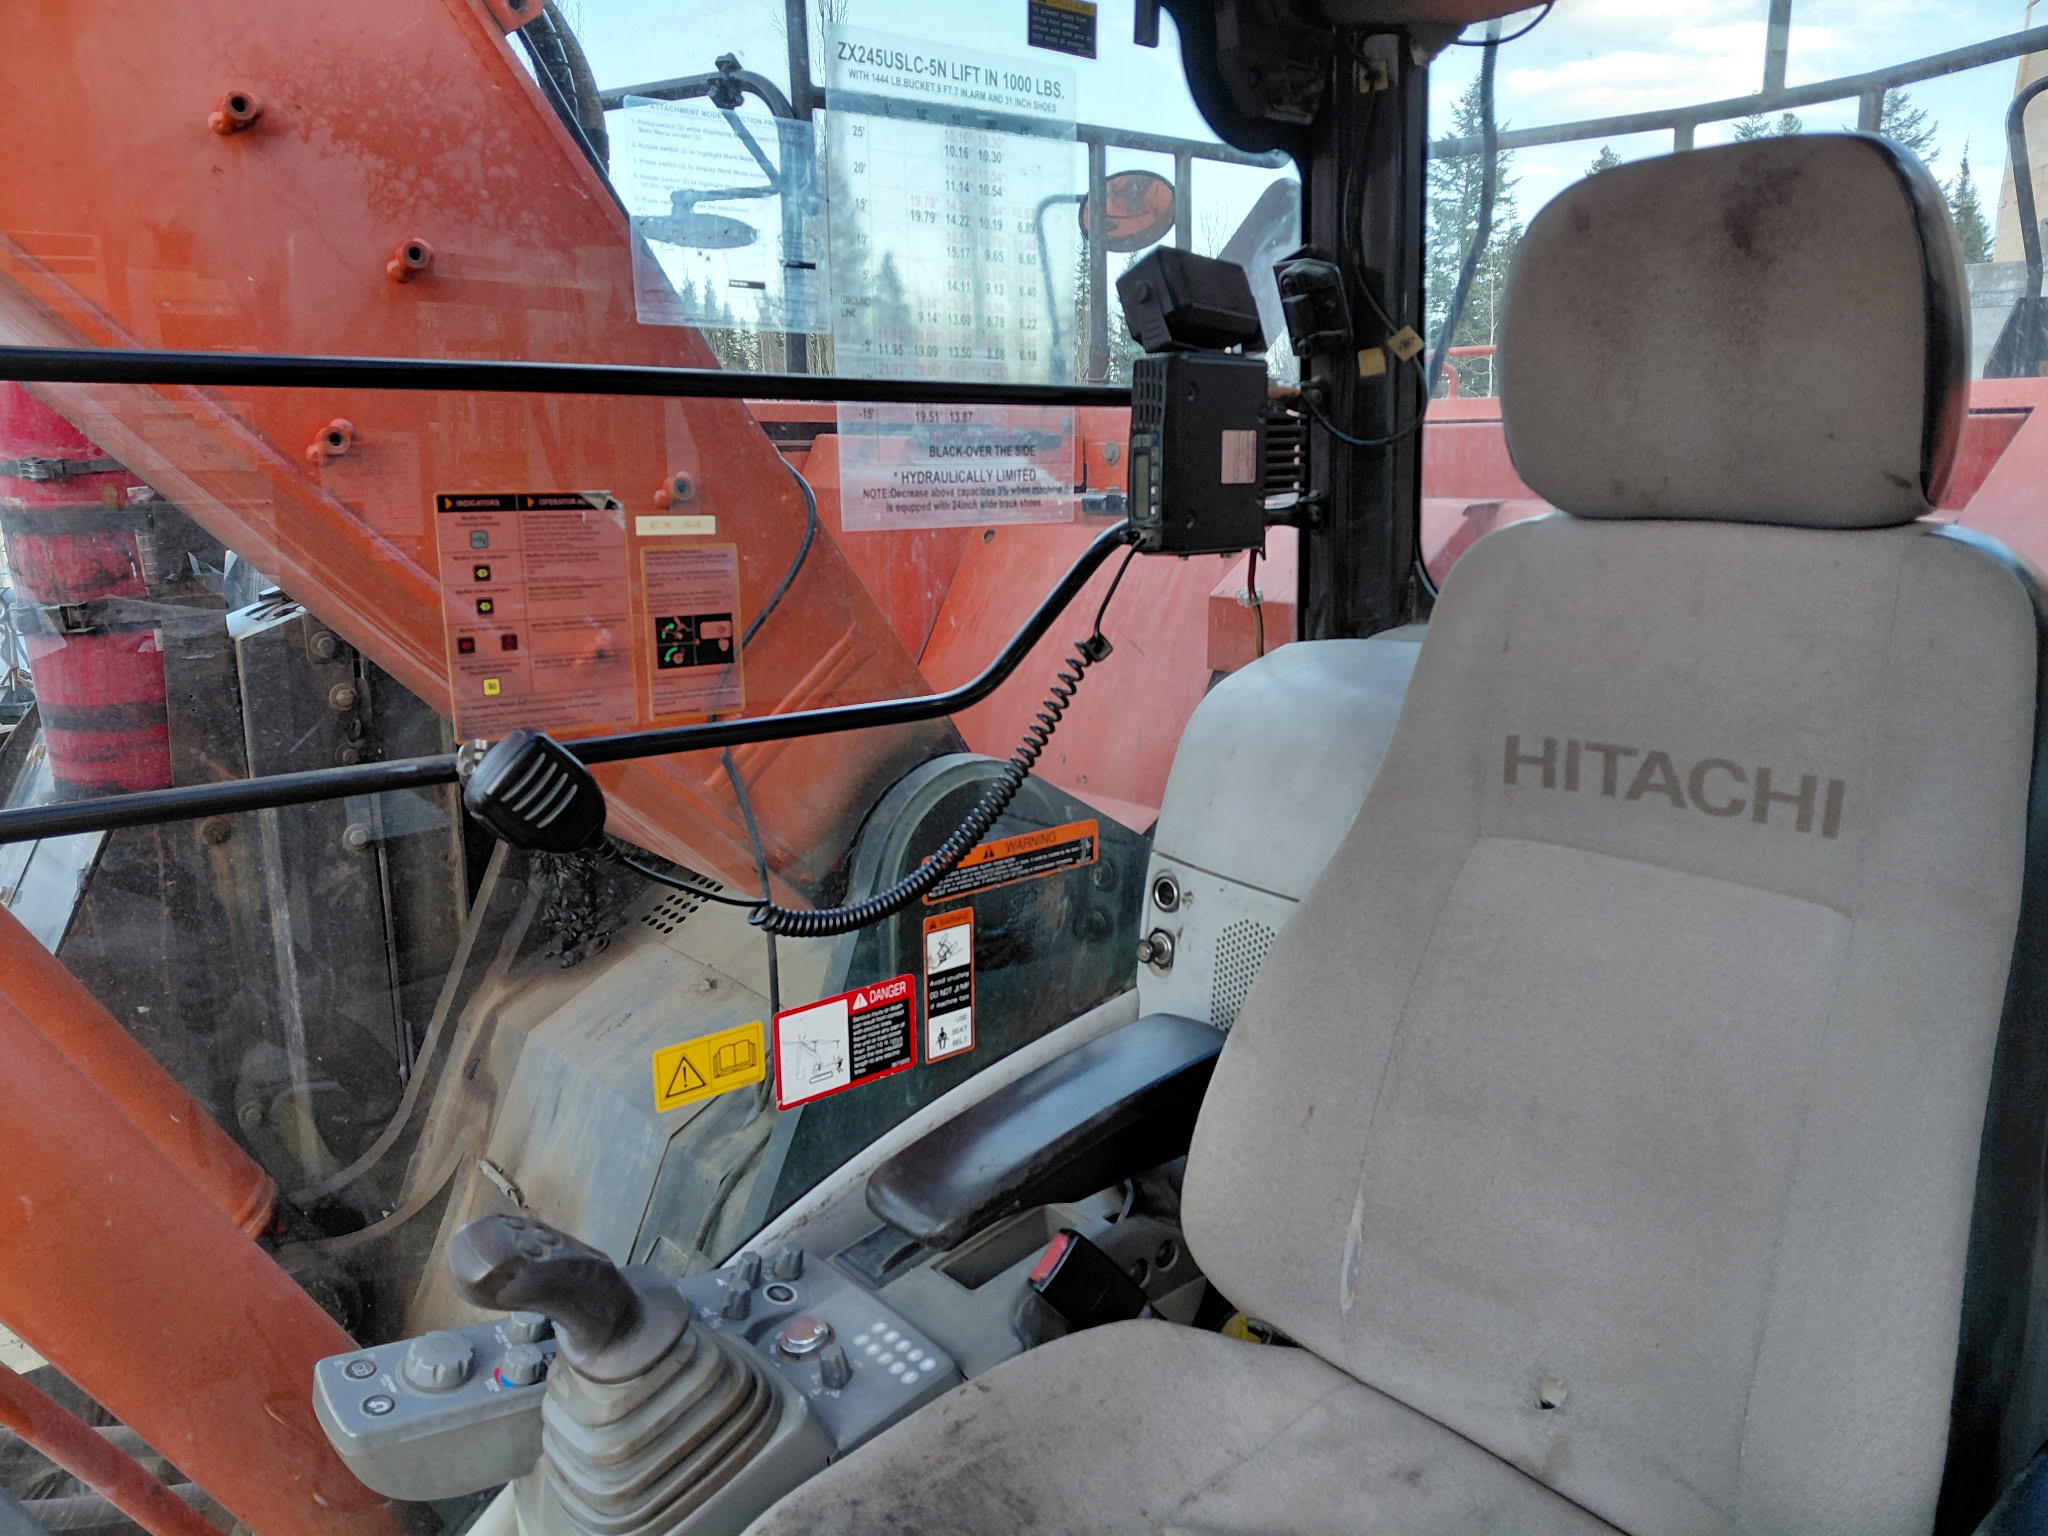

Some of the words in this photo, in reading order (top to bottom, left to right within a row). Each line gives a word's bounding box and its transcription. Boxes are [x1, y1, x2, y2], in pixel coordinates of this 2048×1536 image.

[837, 41, 947, 78] ZX245USLC-5N
[951, 63, 981, 84] LIFT
[984, 69, 998, 87] IN
[1002, 72, 1031, 93] 1000
[1036, 78, 1065, 99] LBS.
[848, 68, 869, 81] WITH
[872, 73, 889, 85] 1444
[988, 93, 1003, 103] AND
[1005, 96, 1013, 105] 31
[1014, 97, 1031, 109] INCH
[1033, 101, 1057, 113] SHOES
[994, 445, 1013, 457] THE
[1015, 444, 1036, 457] SIDE
[901, 470, 993, 484] HYDRAULICALLY
[996, 468, 1037, 482] LIMITED
[930, 486, 954, 498] above
[1503, 734, 1846, 840] HITACHI
[1005, 831, 1057, 853] WARNING
[869, 981, 907, 1004] DANGER
[929, 990, 939, 1000] DO
[939, 986, 952, 997] NOT
[952, 1025, 967, 1035] SEAT
